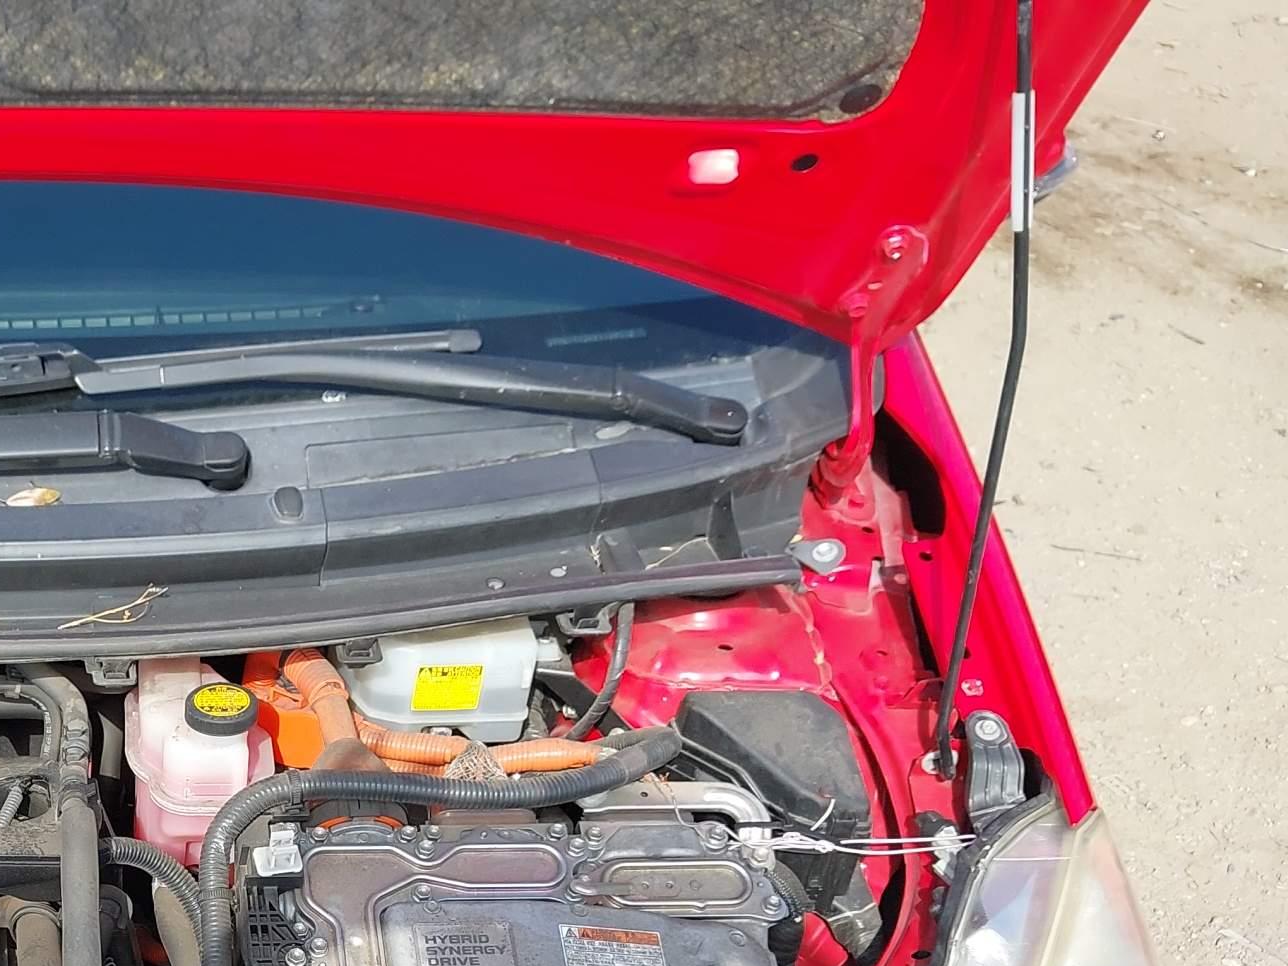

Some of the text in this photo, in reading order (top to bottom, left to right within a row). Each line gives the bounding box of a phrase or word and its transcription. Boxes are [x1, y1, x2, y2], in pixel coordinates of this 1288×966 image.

[424, 934, 490, 944] HYBRID
[425, 945, 506, 956] SYNERGY
[428, 957, 481, 966] DRIVE
